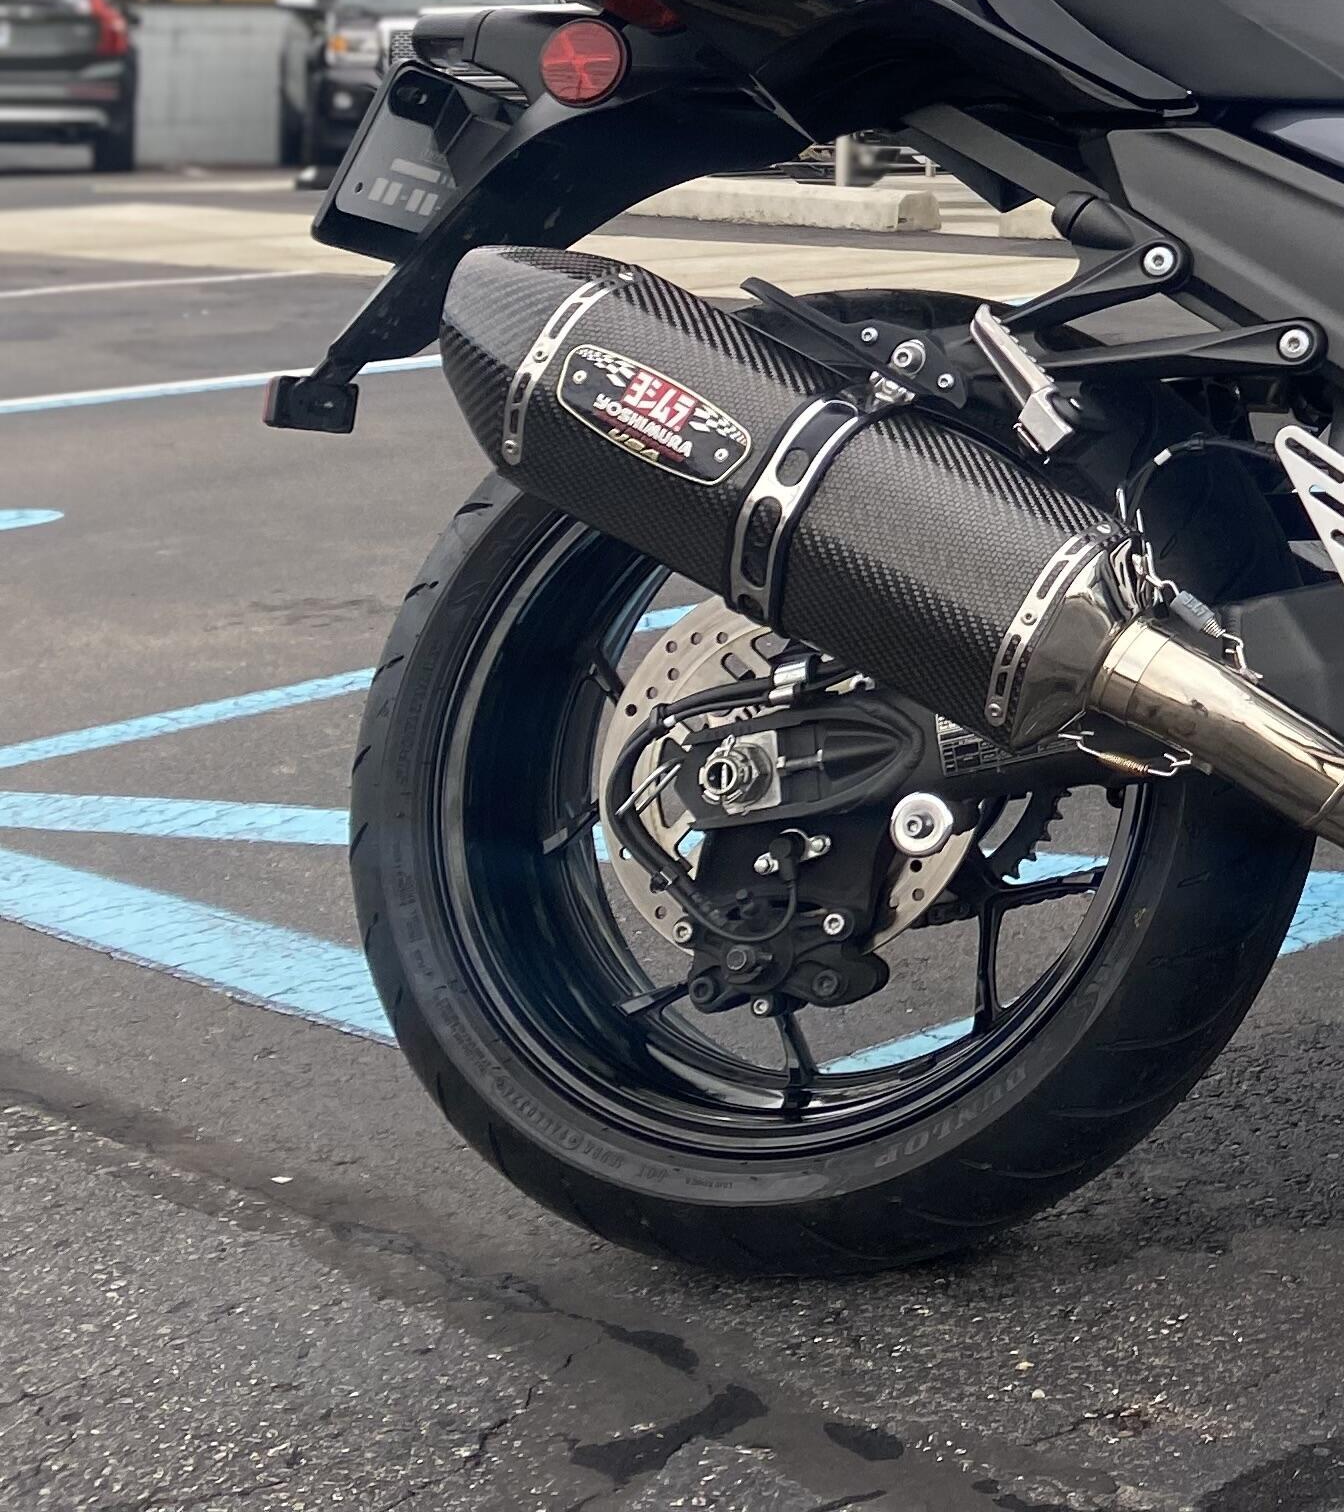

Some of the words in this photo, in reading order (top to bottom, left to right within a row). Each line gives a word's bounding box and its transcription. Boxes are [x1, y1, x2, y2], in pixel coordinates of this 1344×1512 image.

[593, 392, 693, 458] YOSHIMURA
[621, 370, 697, 432] ヨシムラ
[607, 428, 660, 462] USA
[873, 1061, 1027, 1168] DUNLOP
